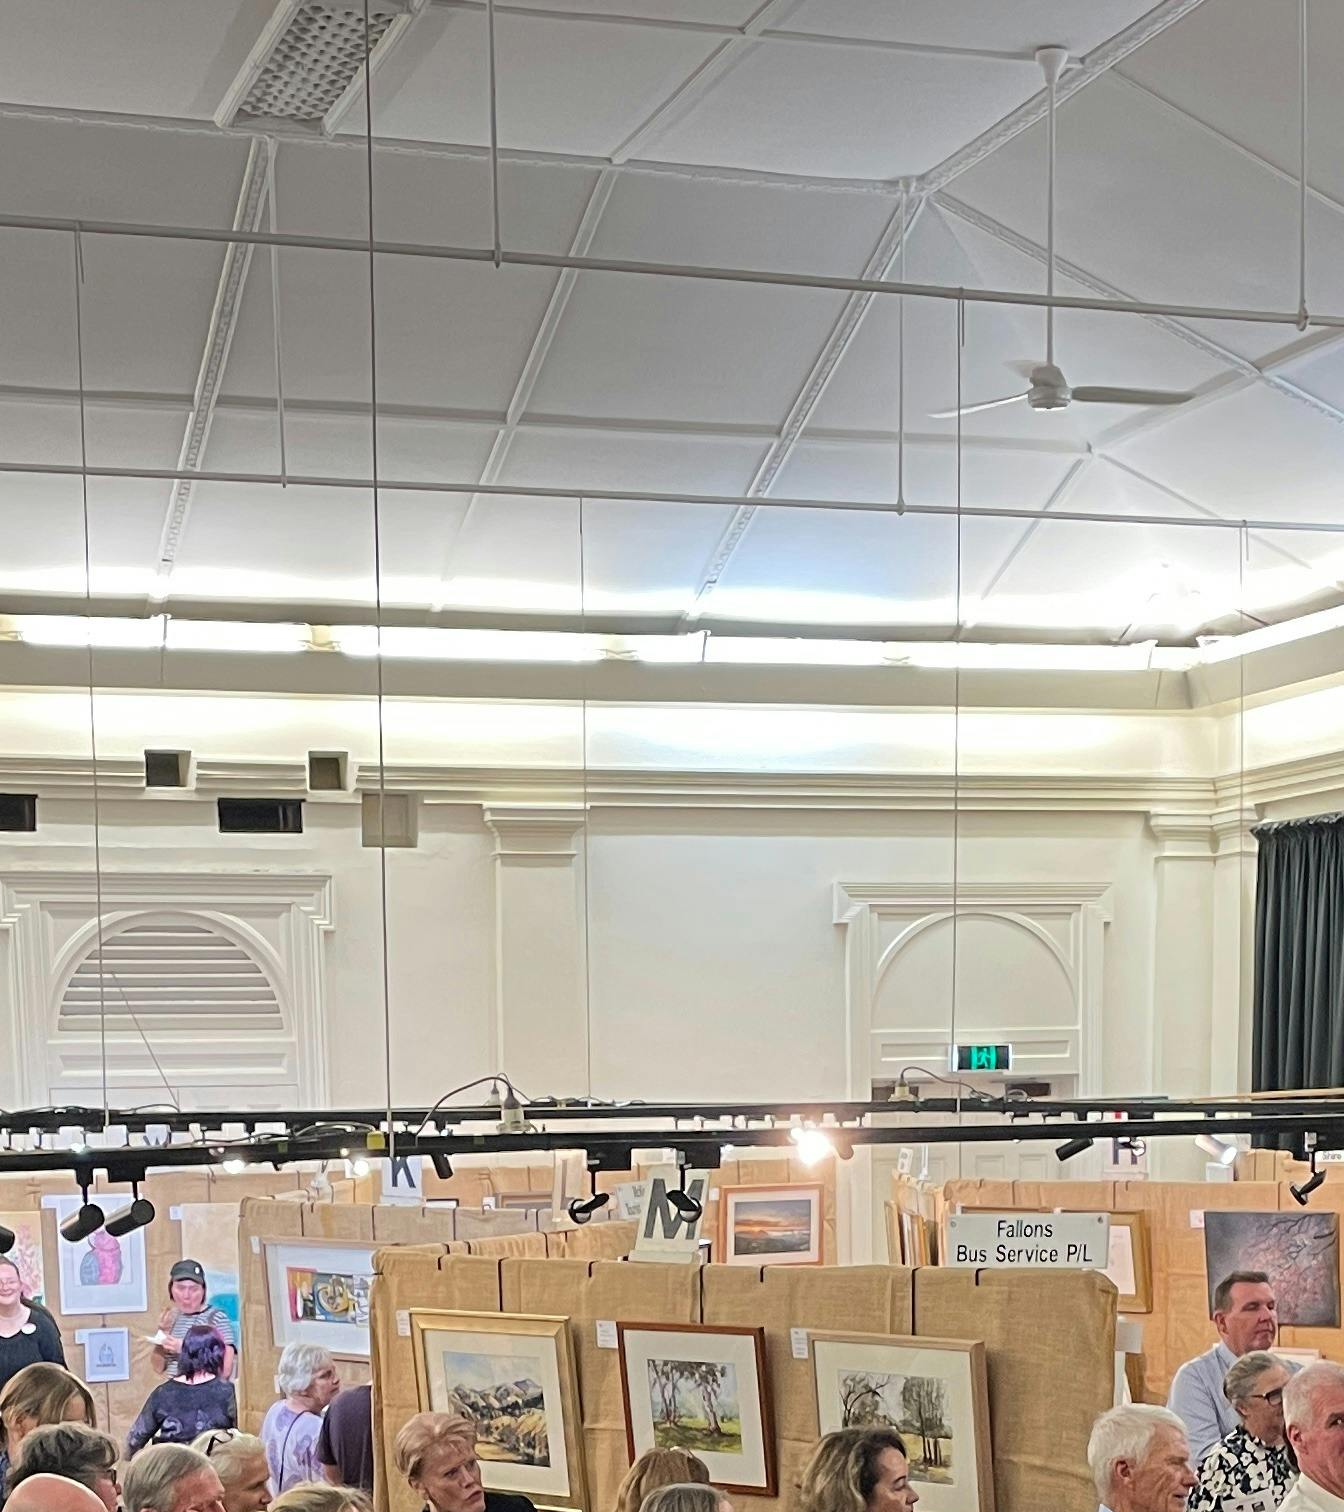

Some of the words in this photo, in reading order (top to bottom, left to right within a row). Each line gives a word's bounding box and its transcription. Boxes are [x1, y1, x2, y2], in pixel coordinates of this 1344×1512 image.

[643, 1177, 705, 1241] M
[997, 1219, 1054, 1239] Fallons
[956, 1244, 988, 1263] Bus
[995, 1243, 1059, 1264] Service
[1066, 1243, 1093, 1263] P/L
